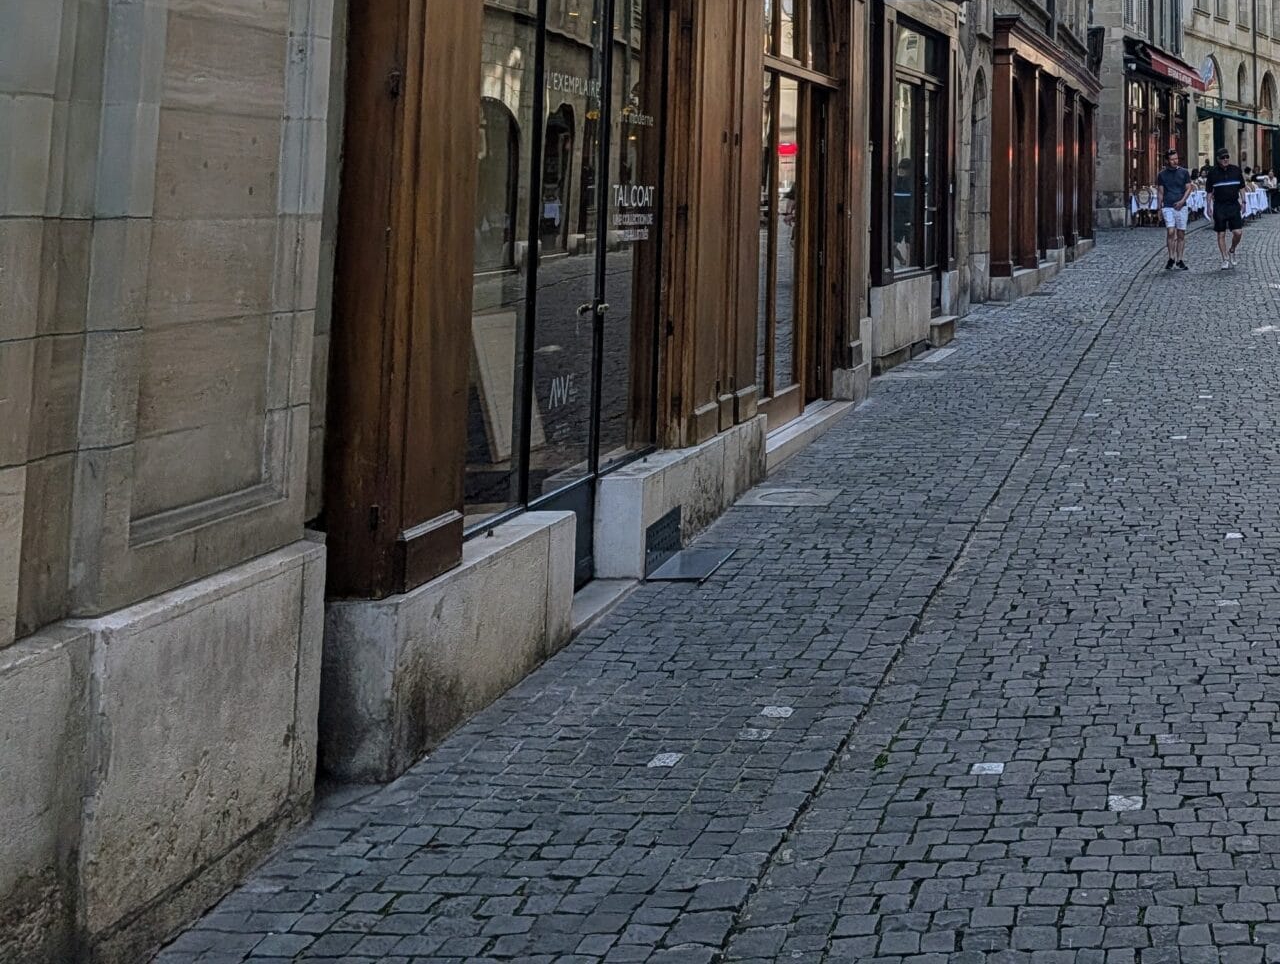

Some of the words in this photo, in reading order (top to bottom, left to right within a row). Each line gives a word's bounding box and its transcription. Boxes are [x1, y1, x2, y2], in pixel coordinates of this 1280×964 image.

[546, 71, 600, 98] L'EXEMPLAIRE
[613, 184, 629, 207] TAL
[631, 184, 655, 207] COAT
